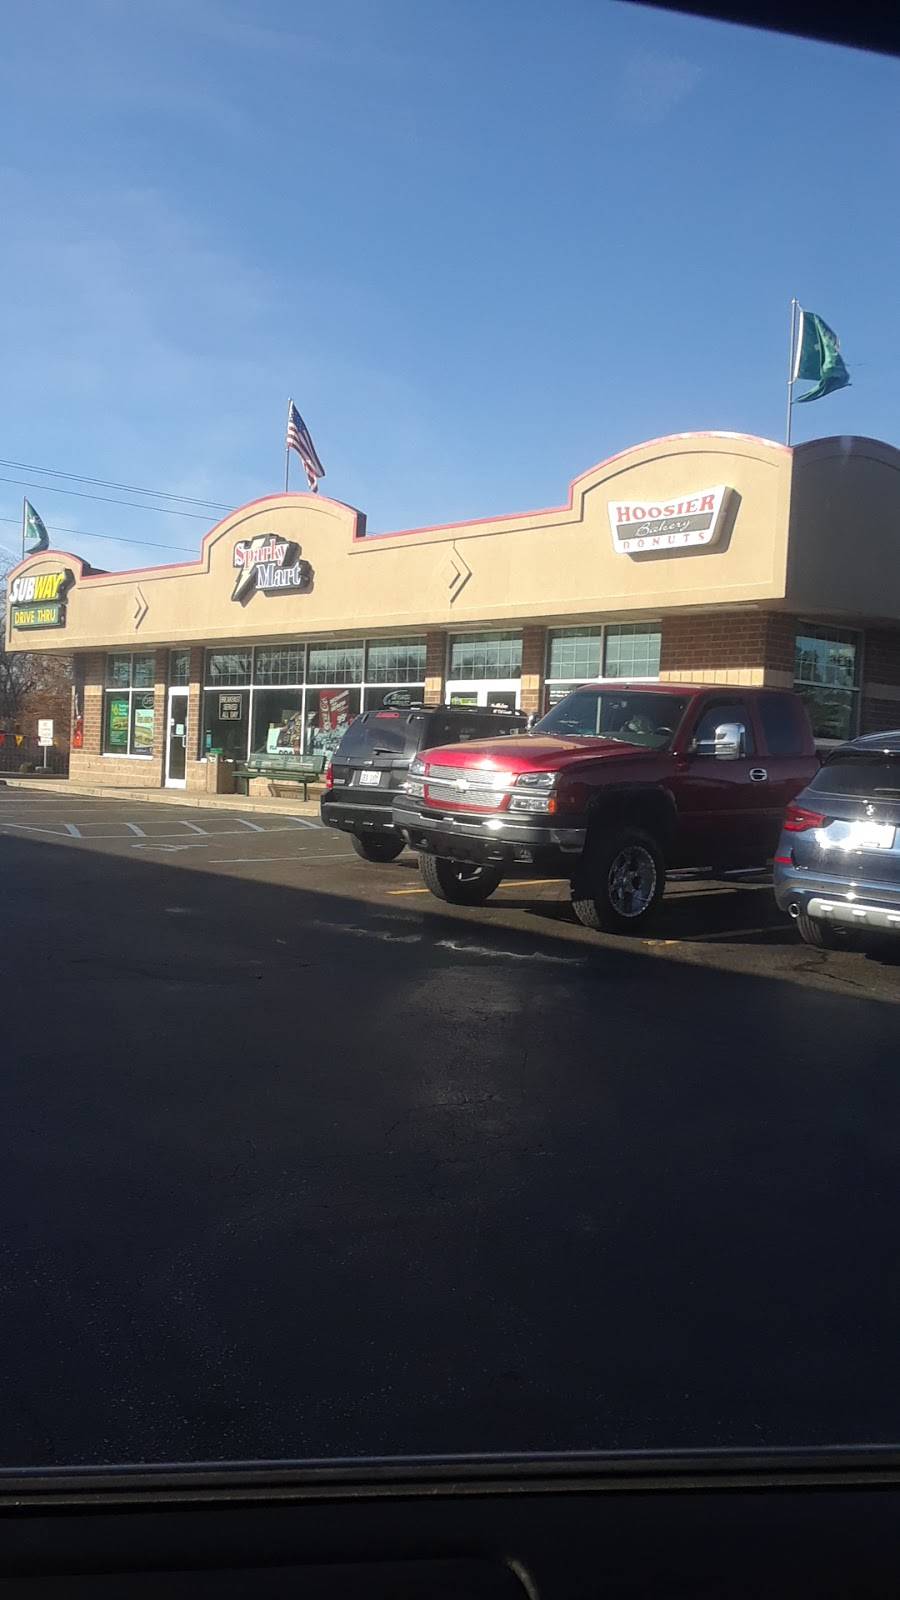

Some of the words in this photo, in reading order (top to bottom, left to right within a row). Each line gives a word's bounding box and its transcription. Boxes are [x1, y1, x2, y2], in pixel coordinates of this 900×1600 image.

[616, 494, 716, 523] HOOSIER
[622, 532, 705, 549] DONUTS
[635, 518, 691, 537] Bakery
[235, 539, 289, 568] Sparky
[9, 571, 65, 603] SUBWAY
[256, 562, 301, 589] Mart
[15, 611, 35, 625] DRIVE
[38, 608, 56, 622] THRU
